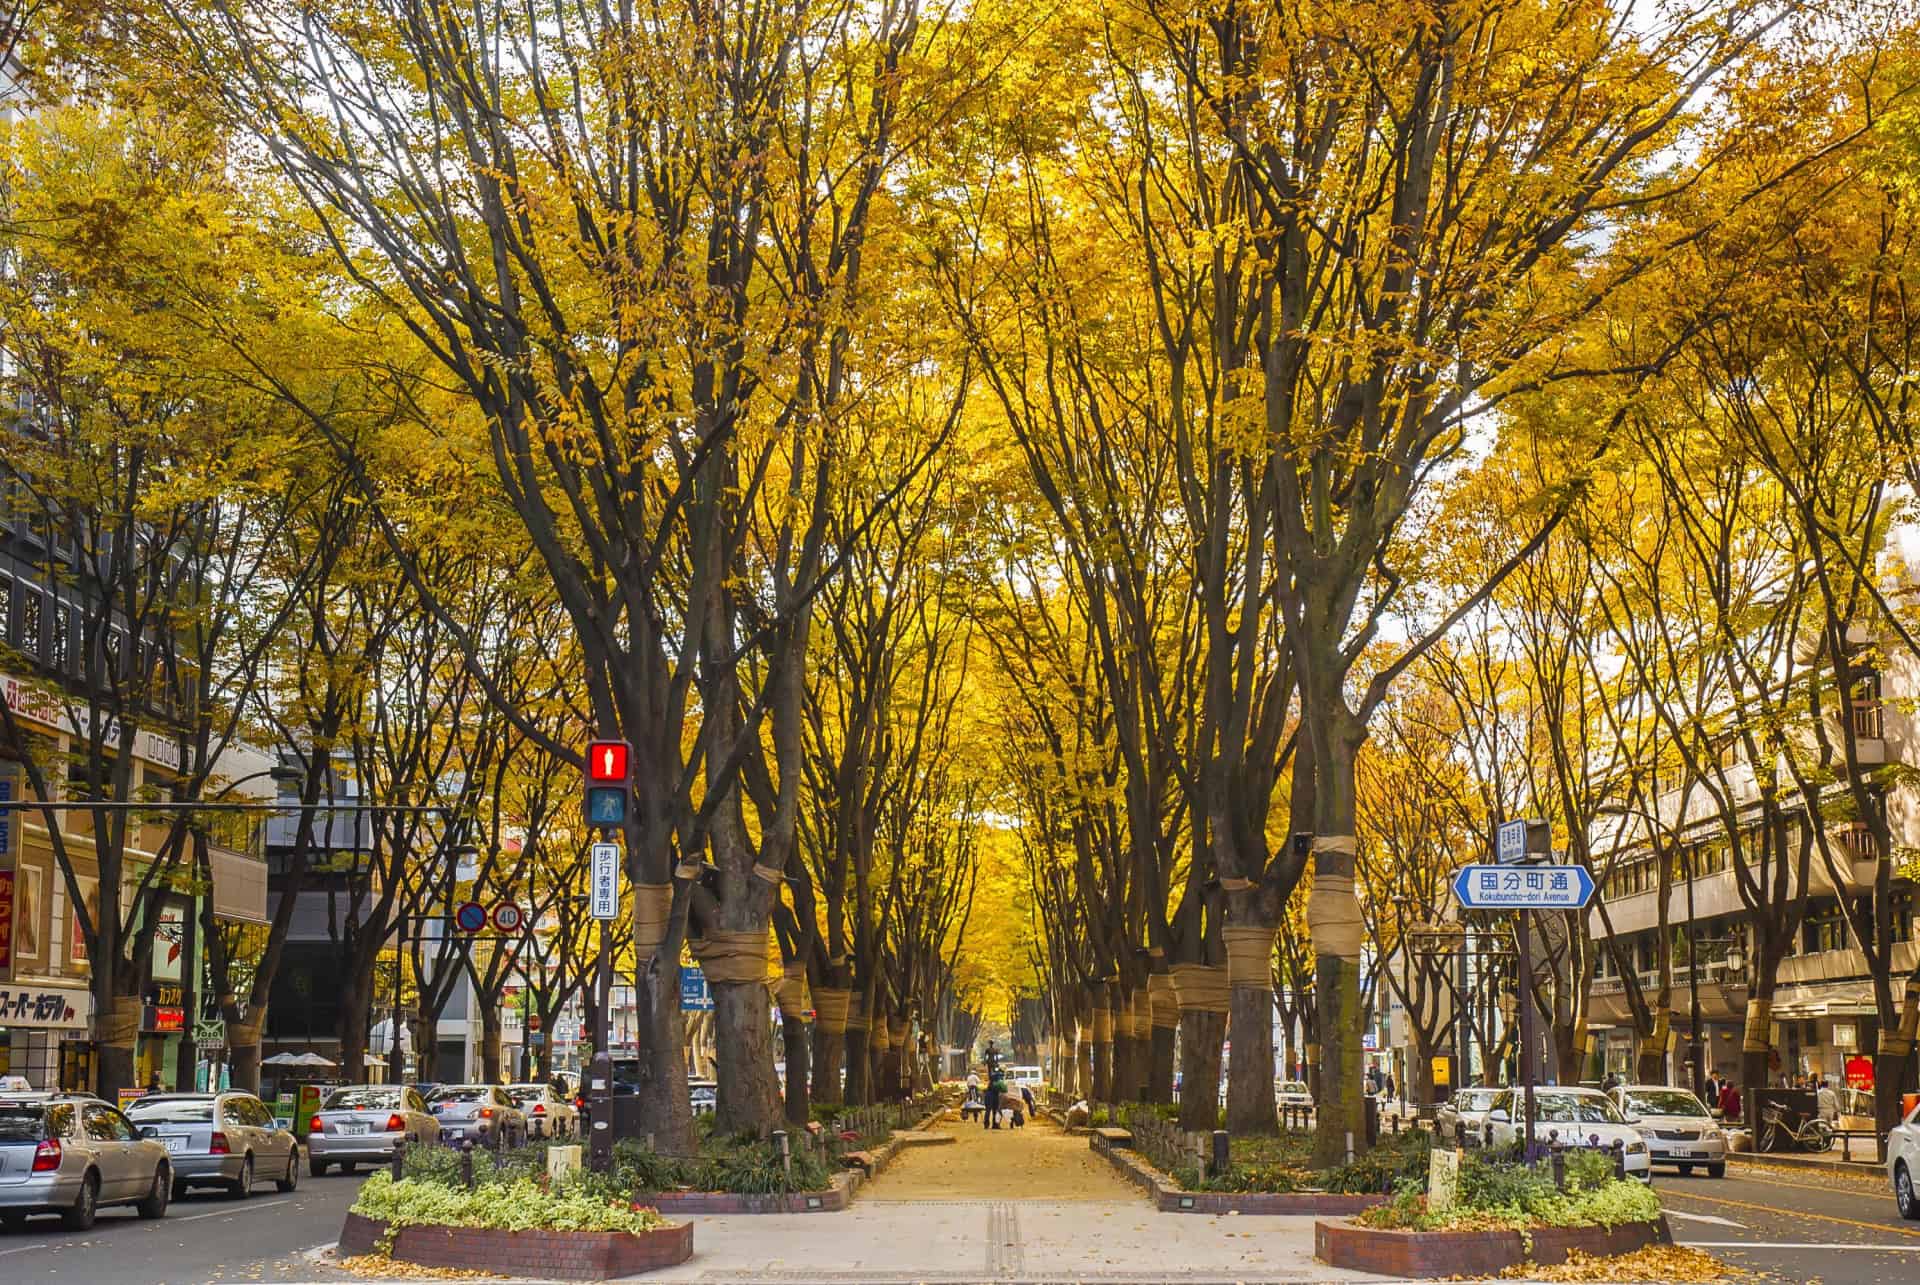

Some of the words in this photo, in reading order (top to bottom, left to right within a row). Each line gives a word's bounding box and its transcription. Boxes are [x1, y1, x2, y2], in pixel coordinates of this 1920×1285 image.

[1480, 872, 1568, 890] 国分町通
[499, 910, 516, 924] 40
[302, 1087, 320, 1104] P
